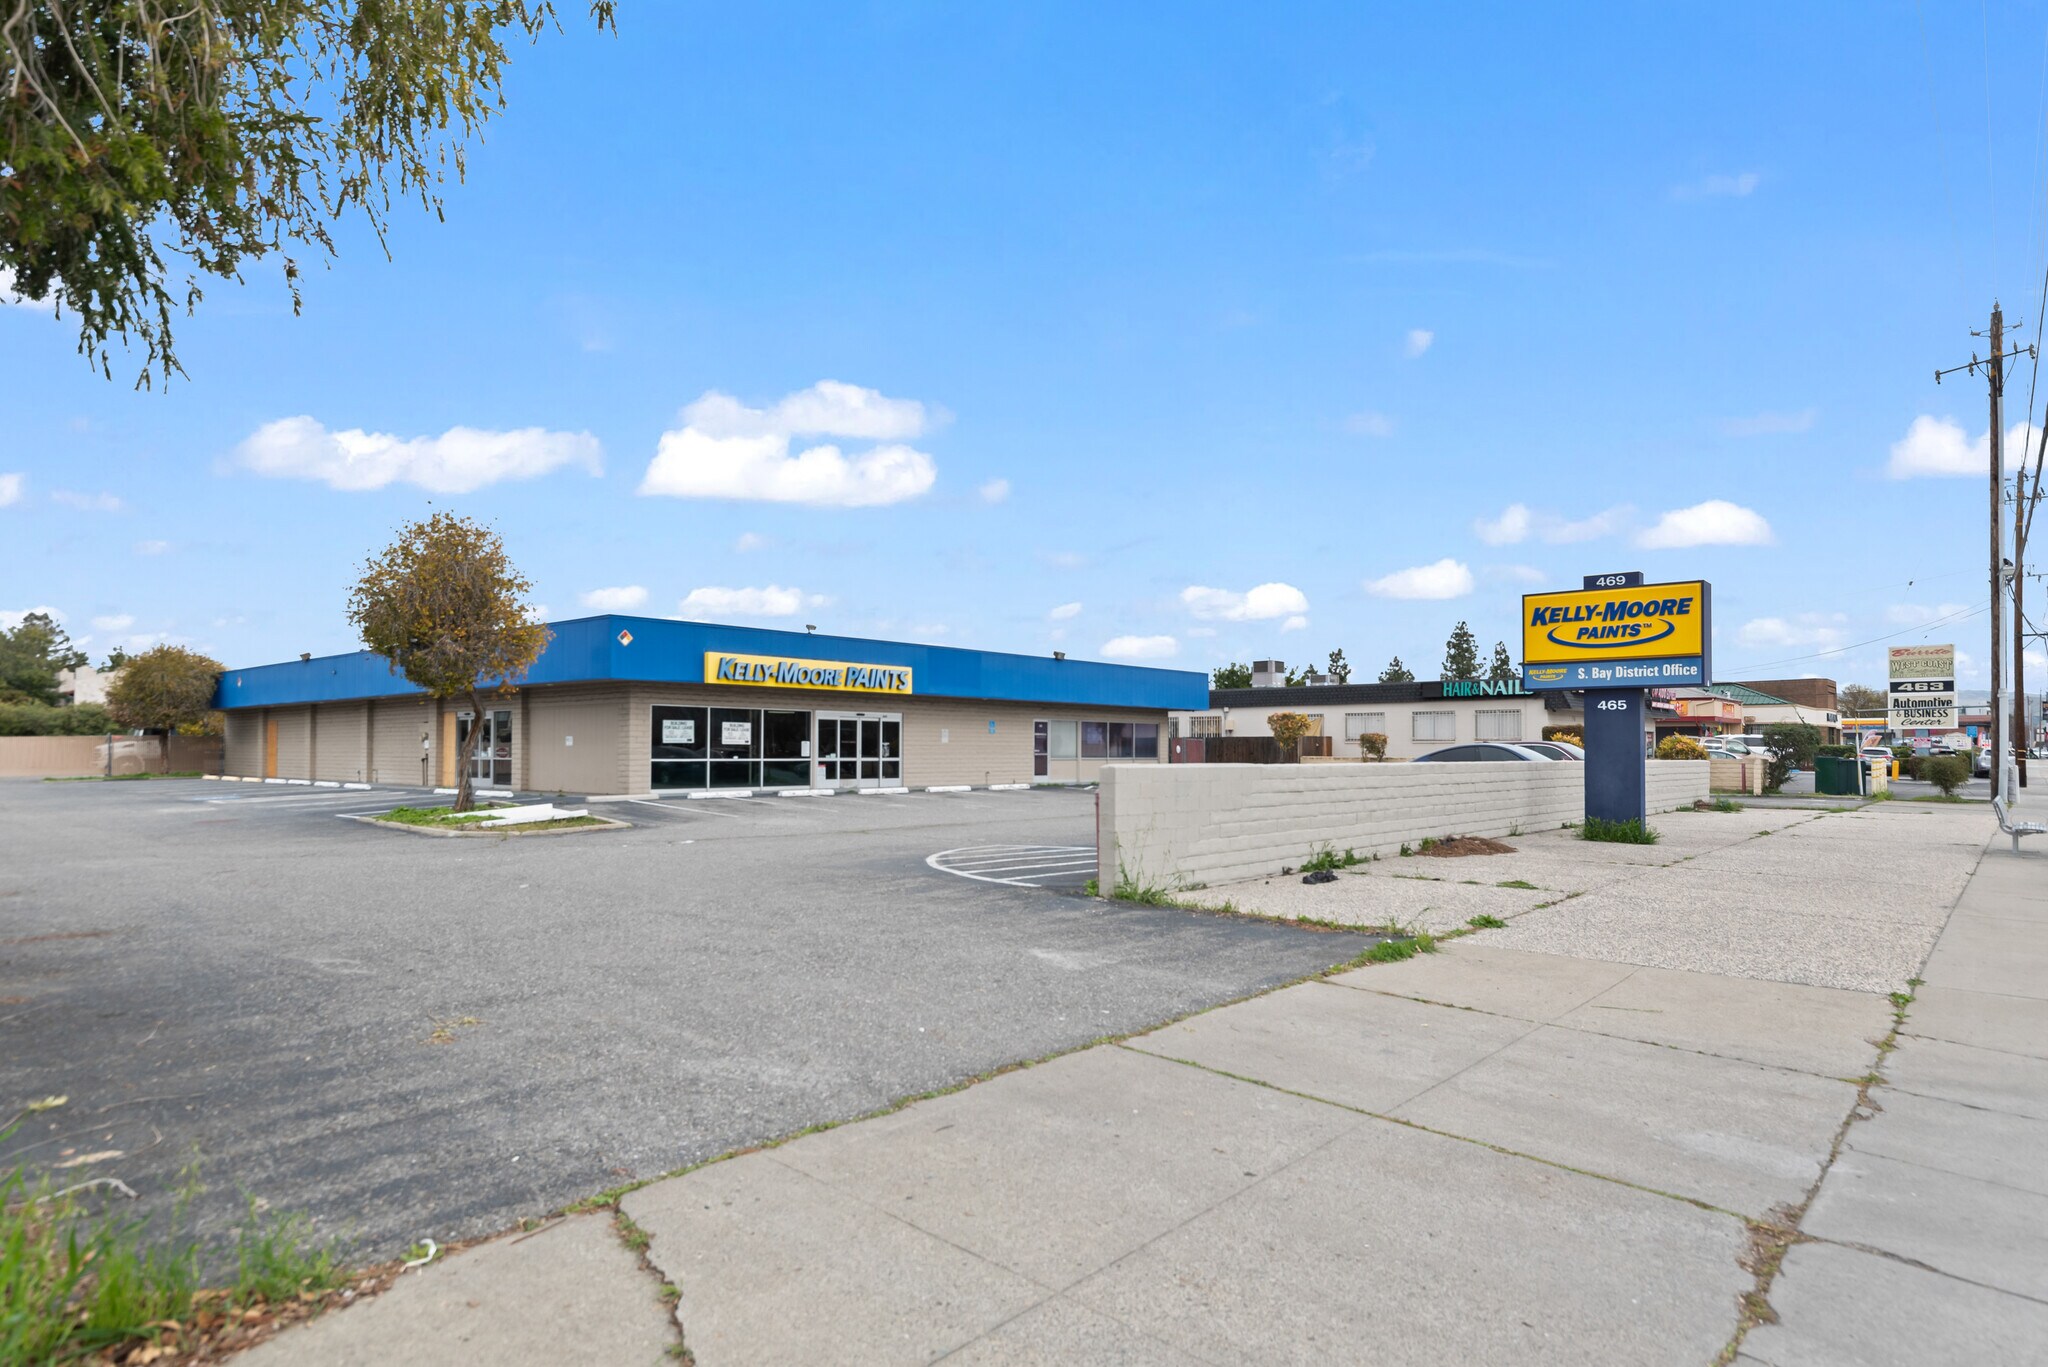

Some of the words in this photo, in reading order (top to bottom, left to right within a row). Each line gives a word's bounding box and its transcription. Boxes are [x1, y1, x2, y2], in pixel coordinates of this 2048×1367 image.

[1596, 575, 1626, 587] 469
[1530, 597, 1694, 627] KELLY-MOORE
[1576, 623, 1642, 641] PAINTS
[718, 657, 844, 686] KELLY-MOORE
[845, 666, 910, 690] PAINTS
[1577, 667, 1588, 679] S.
[1592, 667, 1612, 680] Bay
[1615, 665, 1659, 678] District
[1662, 664, 1698, 676] Office
[1897, 682, 1944, 691] 463
[1597, 700, 1627, 710] 465
[1893, 697, 1953, 708] Automotive
[1903, 709, 1949, 718] BUSINESS
